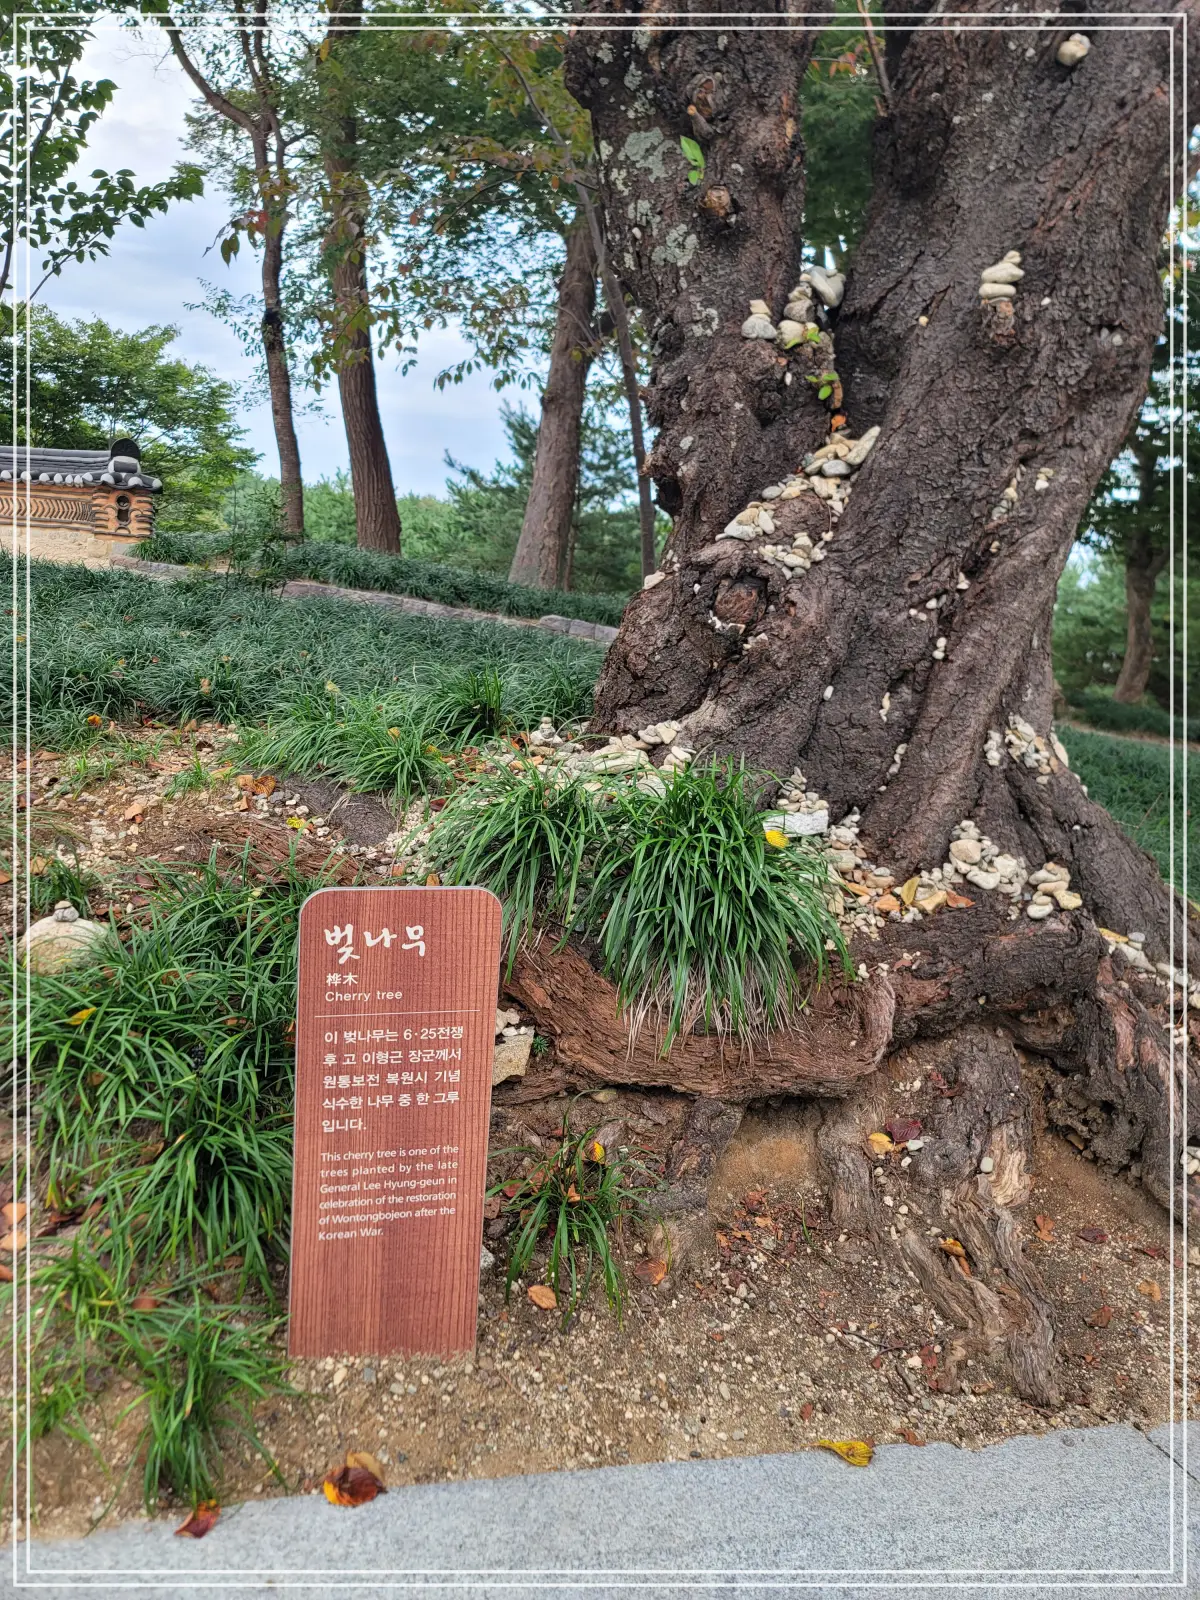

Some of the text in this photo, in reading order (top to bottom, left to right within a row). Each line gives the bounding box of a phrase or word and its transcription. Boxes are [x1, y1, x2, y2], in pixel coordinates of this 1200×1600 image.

[324, 924, 426, 964] 벚나무
[325, 990, 403, 1002] Cherry tree
[325, 1031, 338, 1044] 이
[343, 1029, 399, 1044] 벚나무는
[323, 1048, 461, 1066] 후 고 이형근 장군께서
[323, 1069, 461, 1089] 원통보전 복원시 기념
[322, 1091, 459, 1111] 식수한 나무 중 한 그루
[322, 1118, 367, 1133] 입니다.
[320, 1145, 459, 1162] This cherry tree is one of the
[320, 1161, 459, 1178] trees planted by the late
[320, 1176, 457, 1194] General Lee Hyung-geun in
[320, 1192, 456, 1210] celebration of the restoration
[319, 1206, 456, 1226] of Wontongbojeon after the
[318, 1227, 384, 1241] Korean War.
